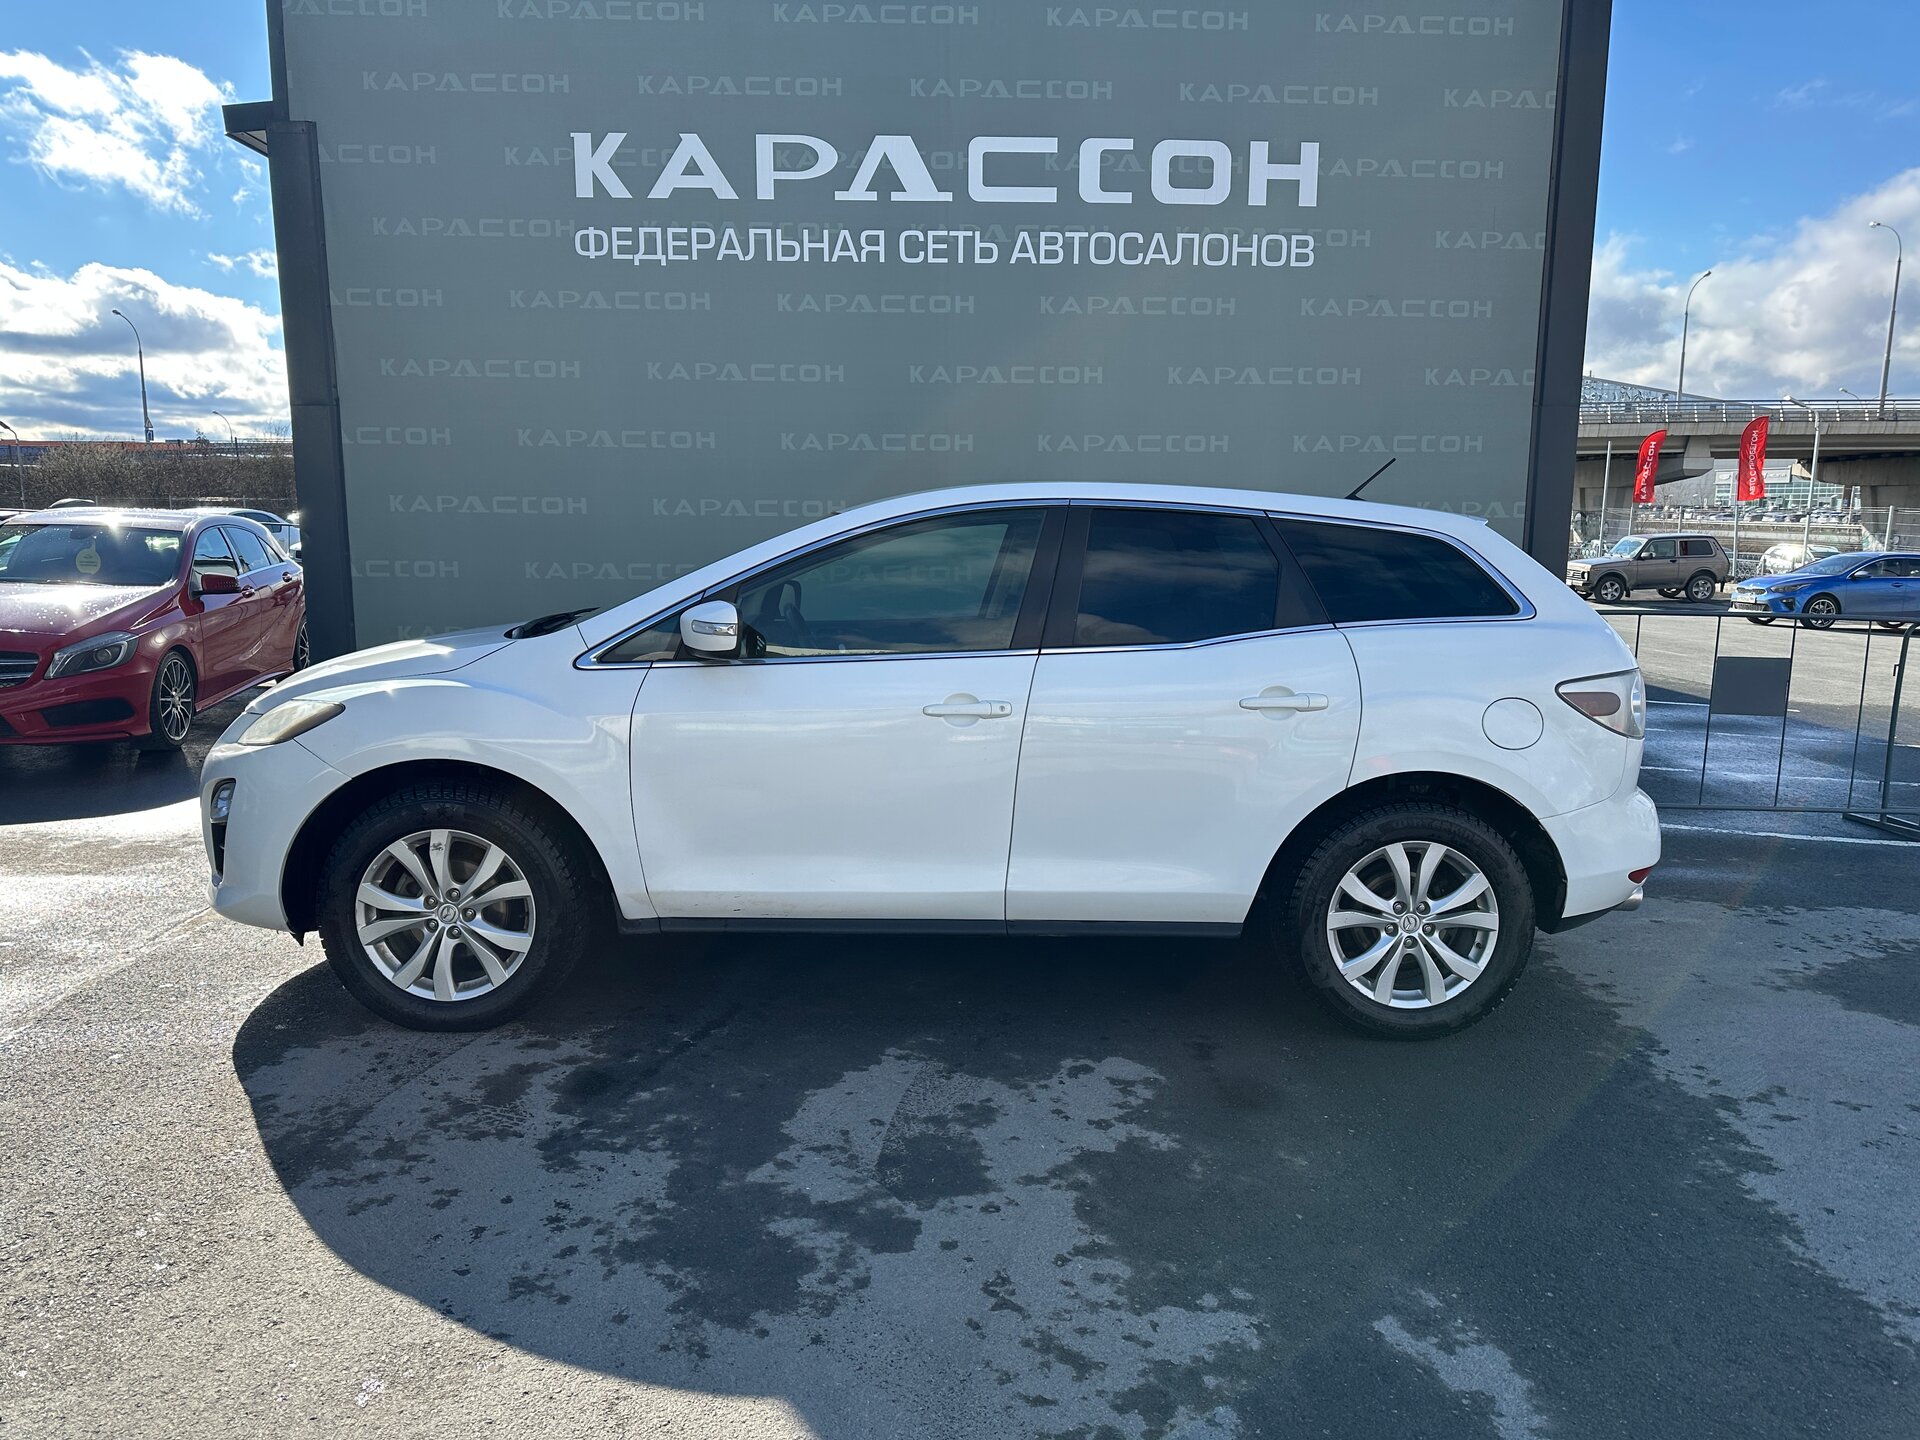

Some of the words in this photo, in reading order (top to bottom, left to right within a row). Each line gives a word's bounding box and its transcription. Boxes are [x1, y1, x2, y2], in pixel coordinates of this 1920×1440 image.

[497, 0, 705, 21] КАРЛССОН
[773, 3, 979, 25] КАРЛССОН
[1046, 7, 1248, 31] КАРЛССОН
[1315, 13, 1514, 36] КАРЛССОН
[362, 71, 569, 93] КАРЛССОН
[638, 75, 842, 97] КАРЛССОН
[910, 79, 1112, 100] КАРЛССОН
[1180, 83, 1378, 106] КАРЛССОН
[569, 131, 1321, 207] КАРЛССОН
[372, 217, 576, 238] КАРЛССОН
[574, 226, 885, 267] ФЕДЕРАЛЬНАЯ
[899, 229, 999, 264] СЕТЬ
[1009, 231, 1315, 268] АВТОСАЛОНОВ
[510, 290, 711, 311] КАРЛССОН
[777, 294, 974, 313] КАРЛССОН
[1040, 296, 1236, 316] КАРЛССОН
[1300, 297, 1492, 318] КАРЛССОН
[380, 359, 580, 379] КАРЛССОН
[647, 362, 844, 383] КАРЛССОН
[909, 365, 1103, 385] КАРЛССОН
[1168, 367, 1361, 386] КАРЛССОН
[517, 429, 716, 449] КАРЛССОН
[780, 433, 973, 453] КАРЛССОН
[1037, 435, 1230, 453] КАРЛССОН
[1293, 435, 1484, 454] КАРЛССОН
[1748, 430, 1759, 470] ПРОБЕГОМ
[389, 495, 587, 515] КАРЛССОН
